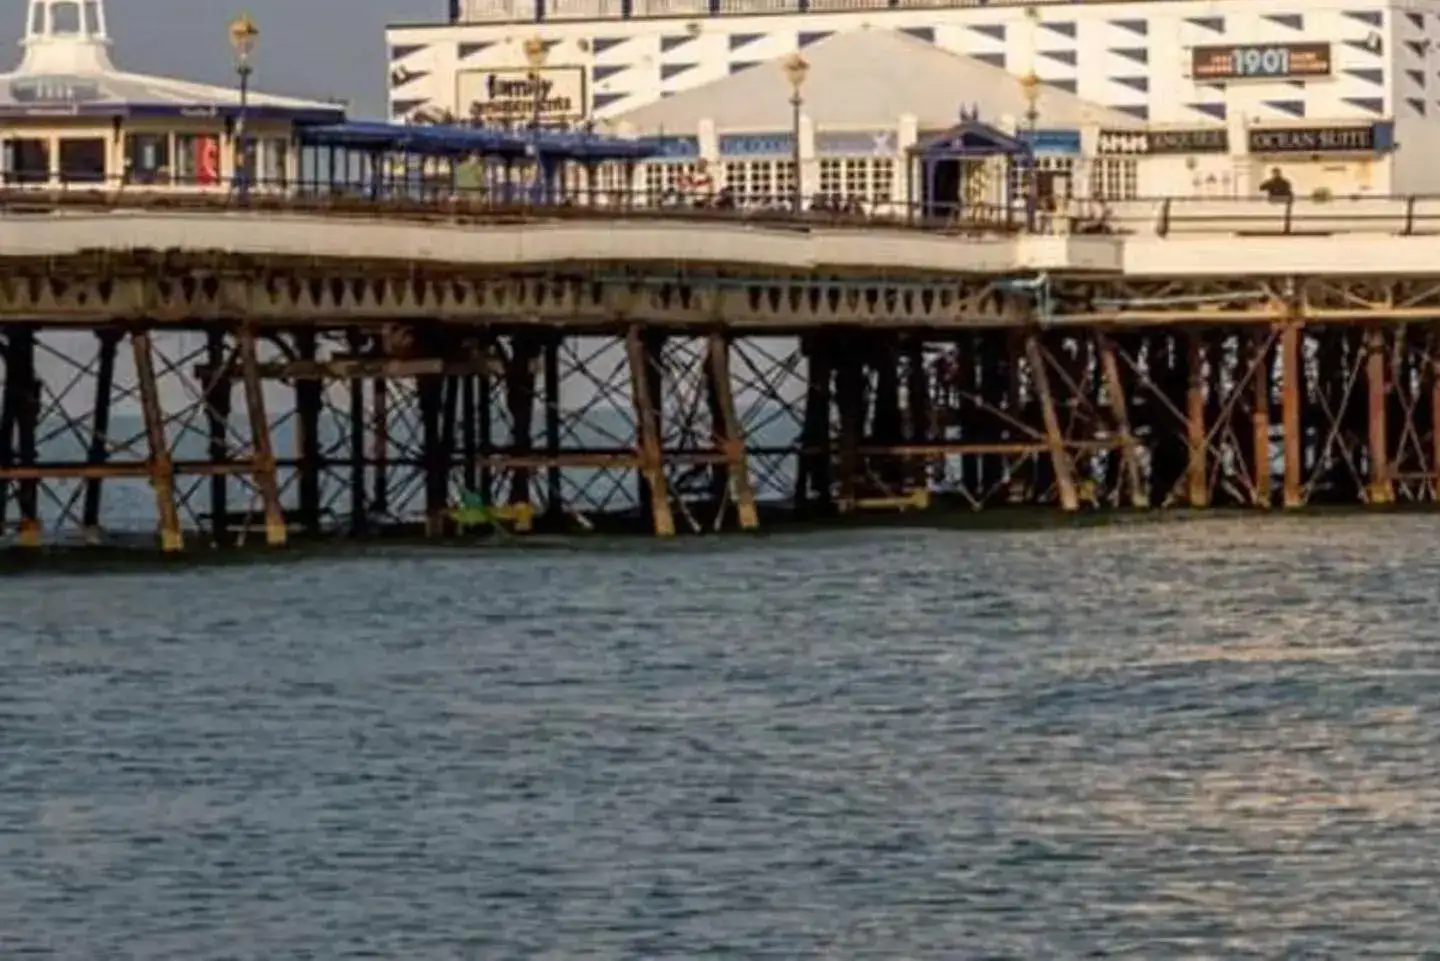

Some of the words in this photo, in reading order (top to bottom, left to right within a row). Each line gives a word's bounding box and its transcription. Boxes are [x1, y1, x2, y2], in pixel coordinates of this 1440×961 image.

[1231, 48, 1289, 75] 1901
[487, 73, 553, 100] family
[1252, 131, 1317, 149] OCEAN
